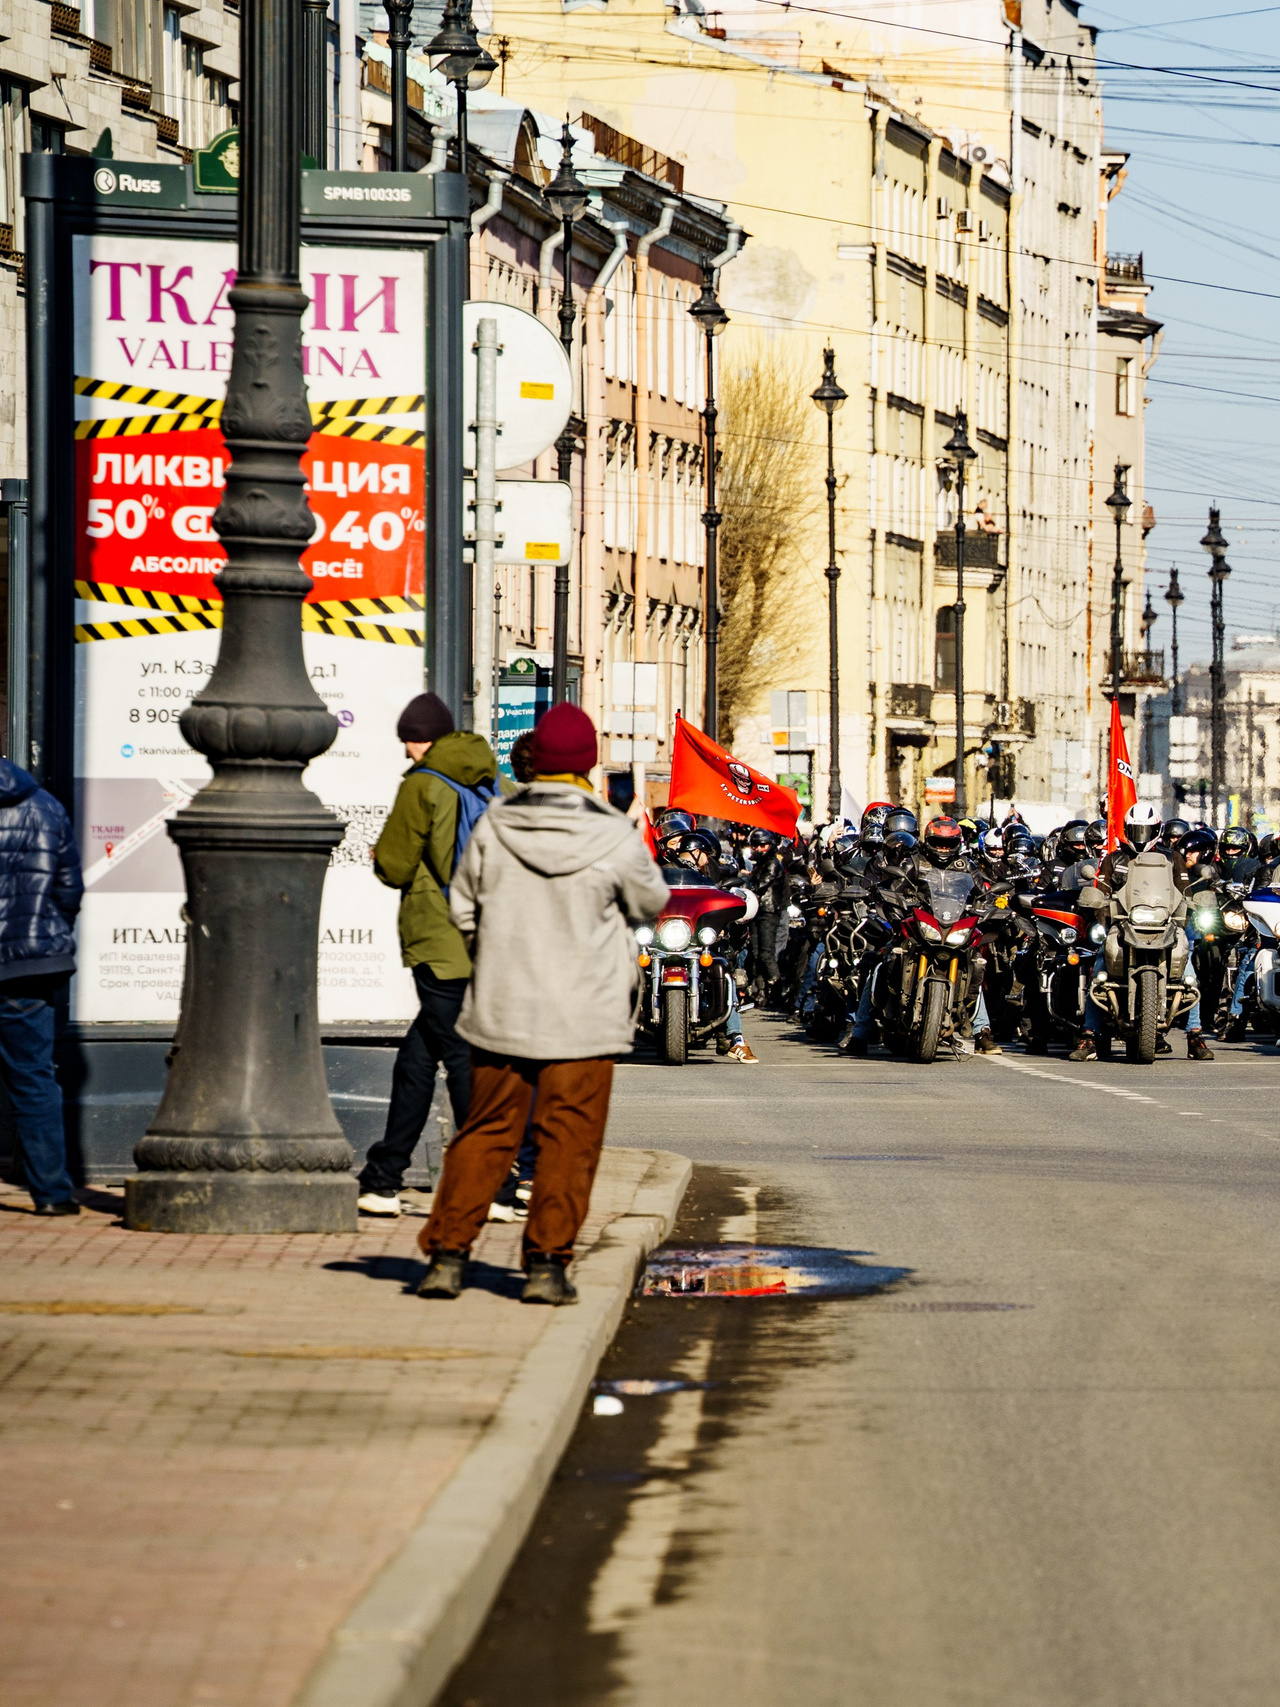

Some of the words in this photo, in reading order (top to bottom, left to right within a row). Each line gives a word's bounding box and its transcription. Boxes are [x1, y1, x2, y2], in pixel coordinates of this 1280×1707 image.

[119, 174, 162, 194] Russ
[117, 337, 382, 379] VALEINA
[92, 452, 411, 498] ЛИКВЦИЯ
[86, 493, 165, 540] 50%
[330, 506, 425, 551] 40%
[130, 556, 229, 574] АБСОЛЮ
[312, 559, 363, 578] ВСЁ!
[140, 661, 168, 677] ул.
[311, 663, 337, 679] д.1
[149, 686, 181, 698] 11:00
[129, 708, 140, 723] 8
[146, 708, 180, 723] 905
[506, 707, 535, 716] Участие
[319, 928, 373, 944] АНИ
[121, 952, 181, 961] Ковалева
[99, 979, 130, 989] Срок
